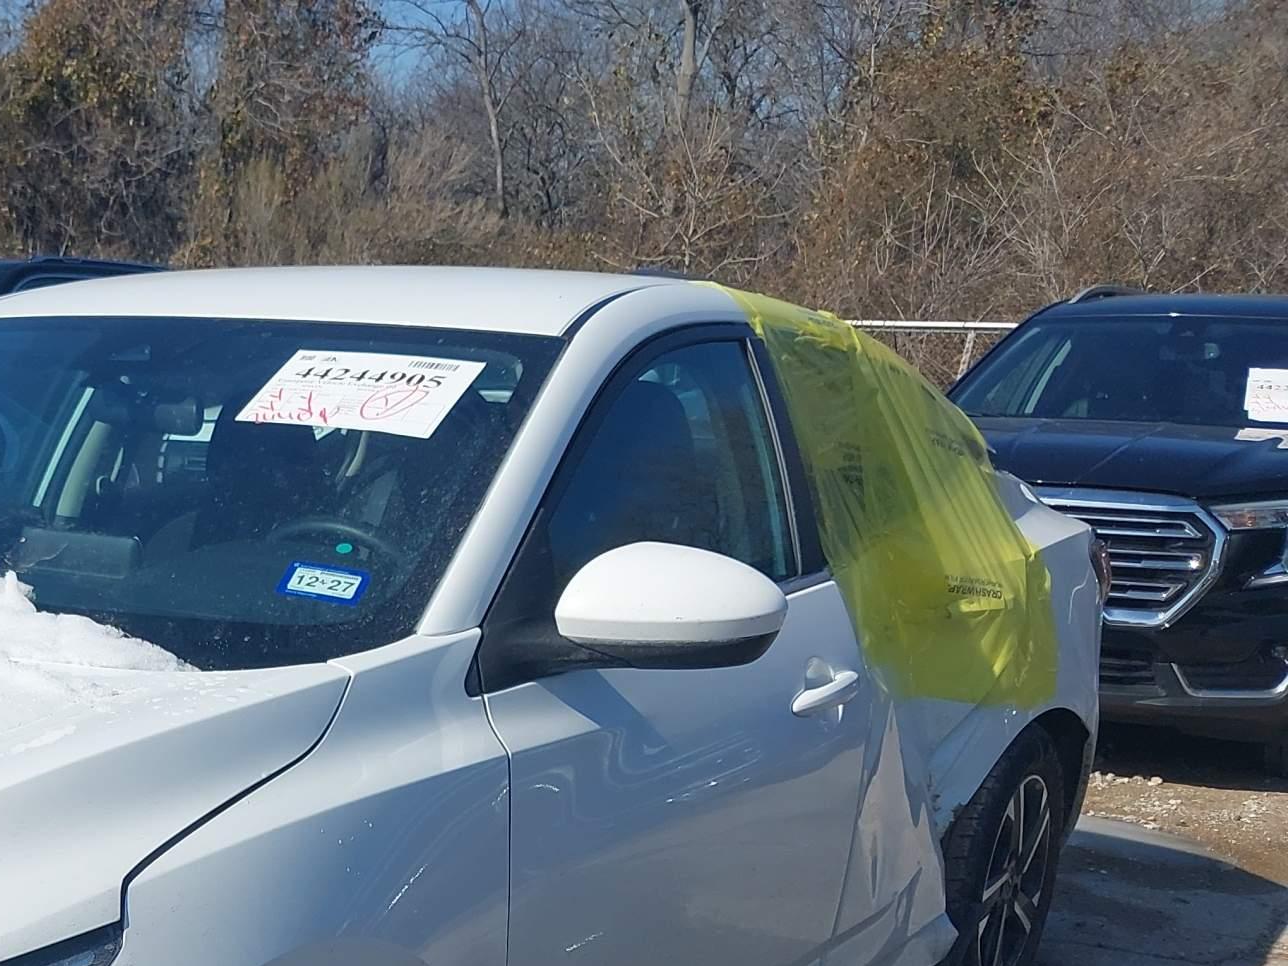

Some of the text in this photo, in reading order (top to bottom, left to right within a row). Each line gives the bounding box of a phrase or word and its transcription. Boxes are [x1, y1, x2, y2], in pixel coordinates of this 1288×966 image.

[294, 366, 448, 389] 44244905
[297, 574, 320, 588] 12
[326, 579, 356, 593] 27
